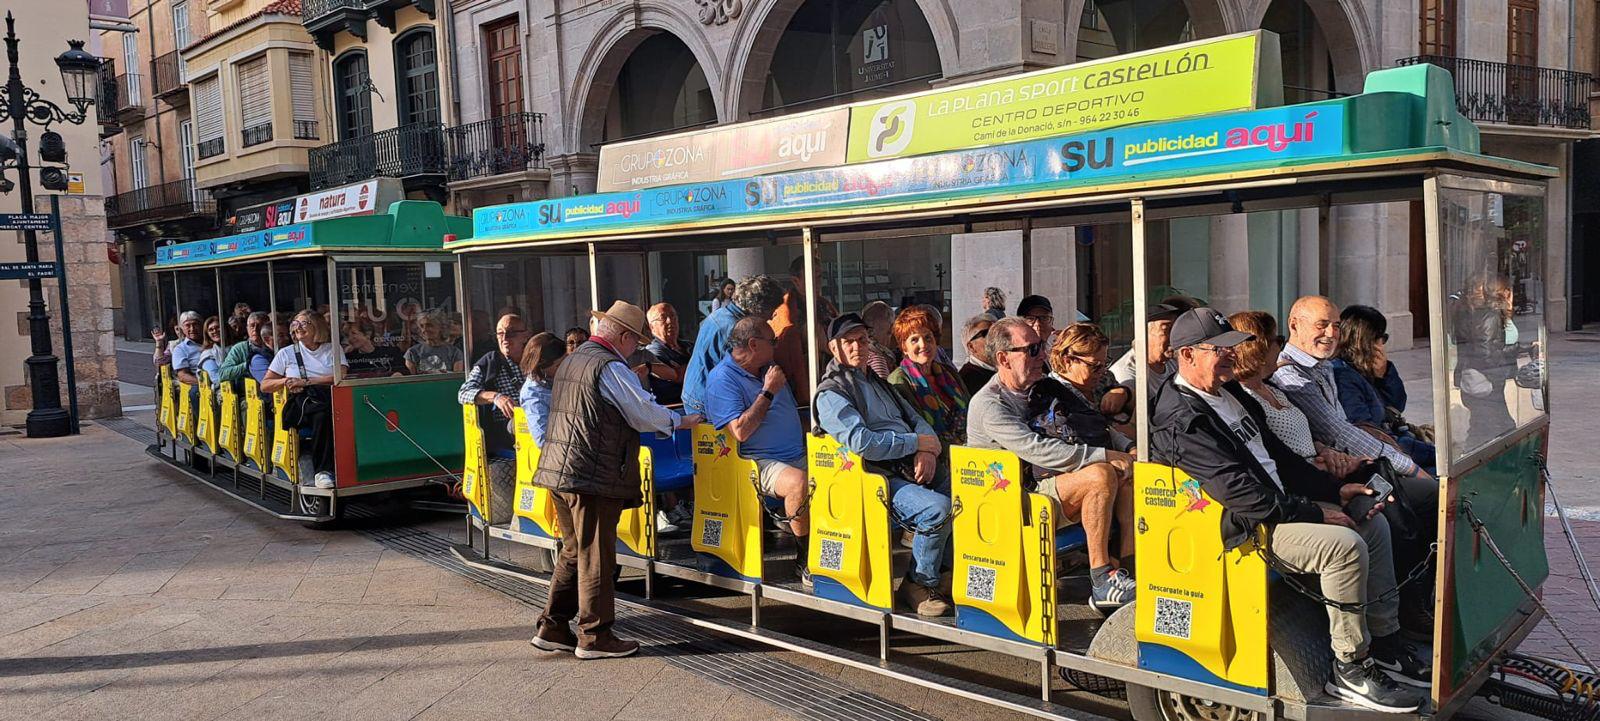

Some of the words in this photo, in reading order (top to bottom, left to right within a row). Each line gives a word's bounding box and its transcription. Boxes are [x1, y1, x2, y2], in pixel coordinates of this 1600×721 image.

[972, 108, 1038, 129] CENTRO
[1042, 90, 1144, 117] DEPORTIVO
[997, 129, 1007, 138] de
[1008, 128, 1016, 136] la
[1057, 118, 1072, 128] s/n
[1079, 113, 1098, 125] 964
[1099, 112, 1112, 122] 22
[1113, 110, 1126, 120] 30
[1127, 108, 1140, 118] 46
[778, 121, 832, 163] aquí
[1124, 131, 1219, 160] publicidad
[1224, 110, 1320, 153] aquí
[783, 177, 839, 200] publicidad
[319, 192, 346, 211] natura
[564, 204, 604, 218] publicidad
[606, 193, 641, 219] aquí
[960, 468, 985, 479] comercio
[1145, 486, 1176, 498] comercio
[1145, 496, 1177, 508] castellón
[1184, 588, 1190, 597] la
